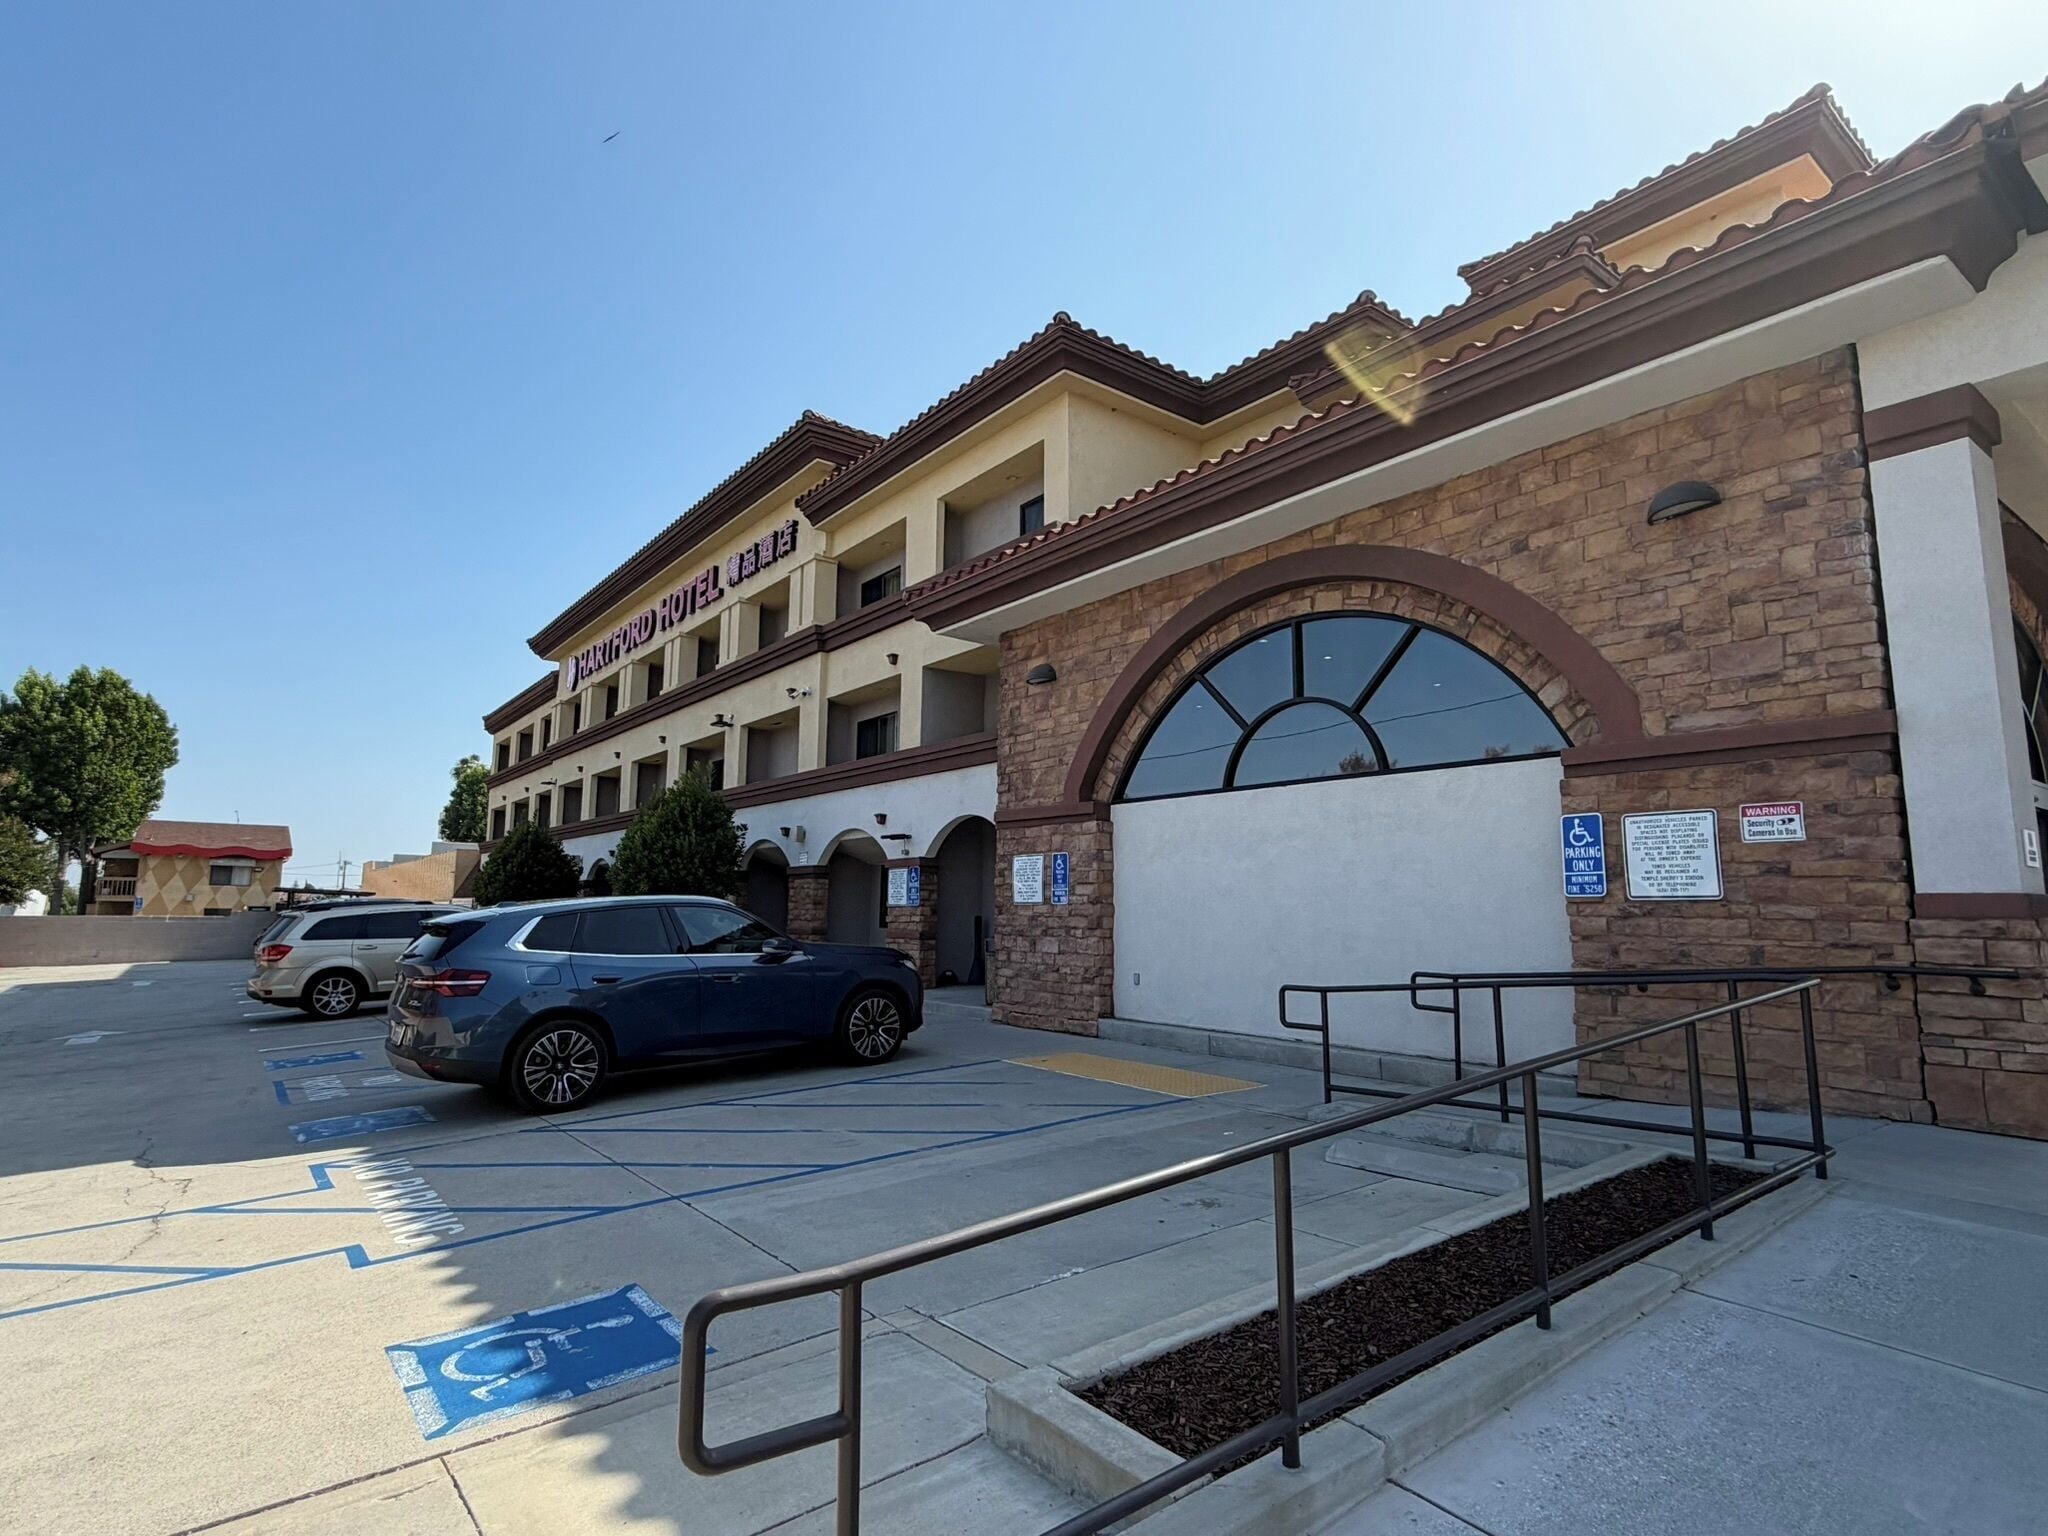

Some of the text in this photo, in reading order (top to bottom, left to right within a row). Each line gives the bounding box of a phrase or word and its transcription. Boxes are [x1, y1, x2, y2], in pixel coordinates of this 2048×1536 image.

[578, 565, 723, 679] HARTFORD HOTEL
[1745, 806, 1796, 816] WARNING
[1747, 819, 1775, 828] Security
[1748, 829, 1775, 837] Cameras
[1565, 846, 1601, 859] PARKING
[1573, 860, 1594, 871] ONLY
[1572, 875, 1598, 883] MINIMUM
[1568, 885, 1580, 893] FINE
[351, 1158, 414, 1180] NO
[362, 1177, 465, 1243] PARKING
